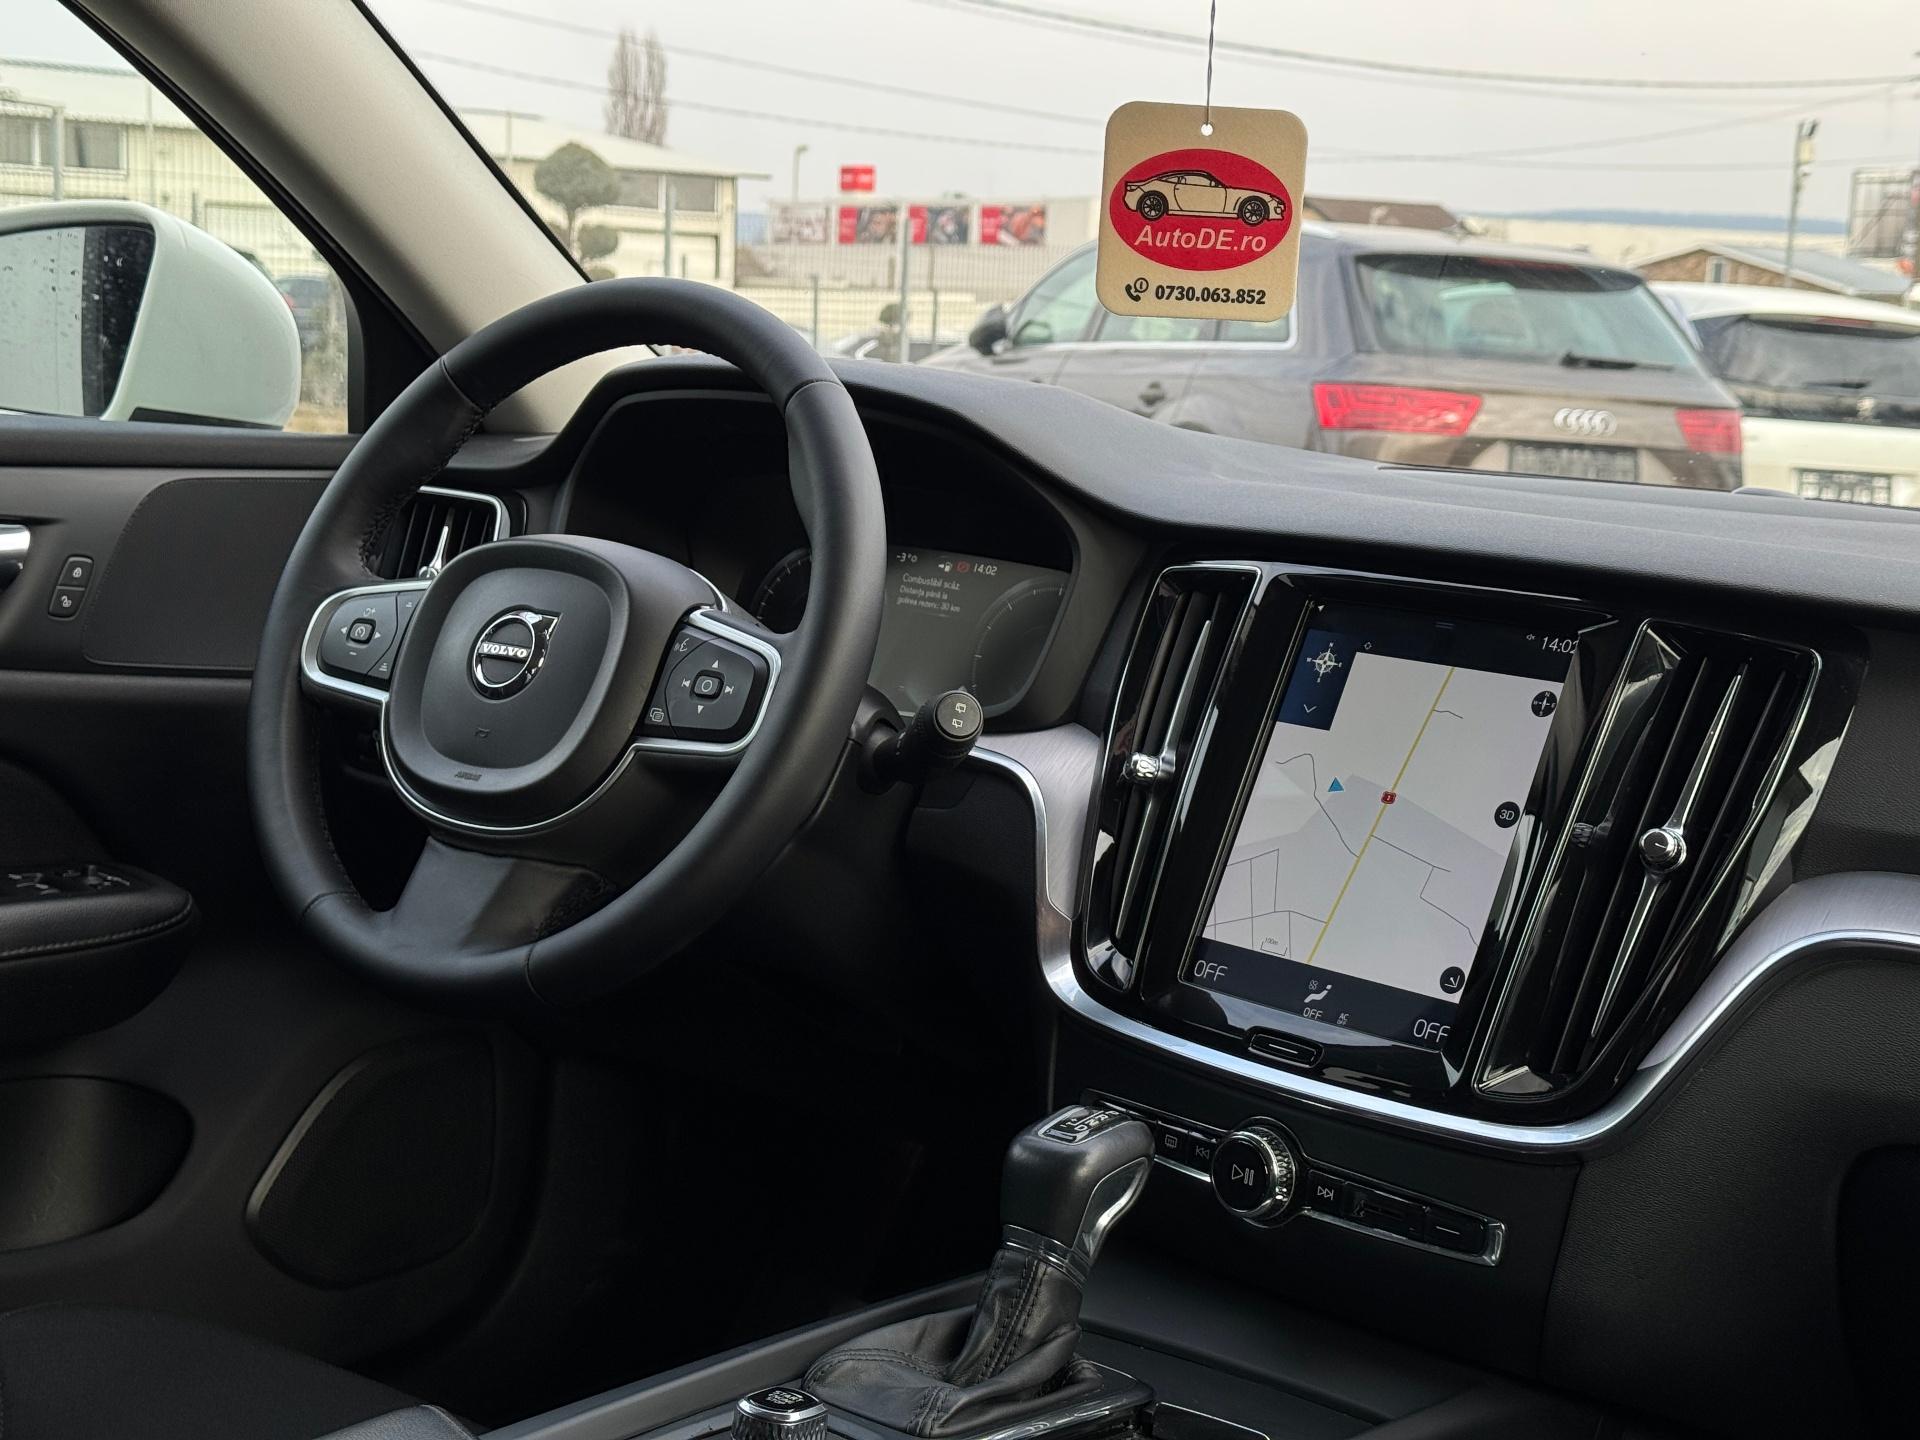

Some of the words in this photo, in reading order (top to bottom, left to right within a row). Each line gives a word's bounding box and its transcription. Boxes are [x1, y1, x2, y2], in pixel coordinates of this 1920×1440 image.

[1134, 225, 1267, 252] AutoDE.ro
[1155, 285, 1266, 305] 0730.063.852
[974, 563, 998, 576] 14:02
[482, 643, 528, 658] VOLVO
[1499, 809, 1515, 821] 3D
[1193, 960, 1228, 981] OFF
[1303, 1007, 1323, 1020] OFF
[1413, 1019, 1450, 1043] OFF
